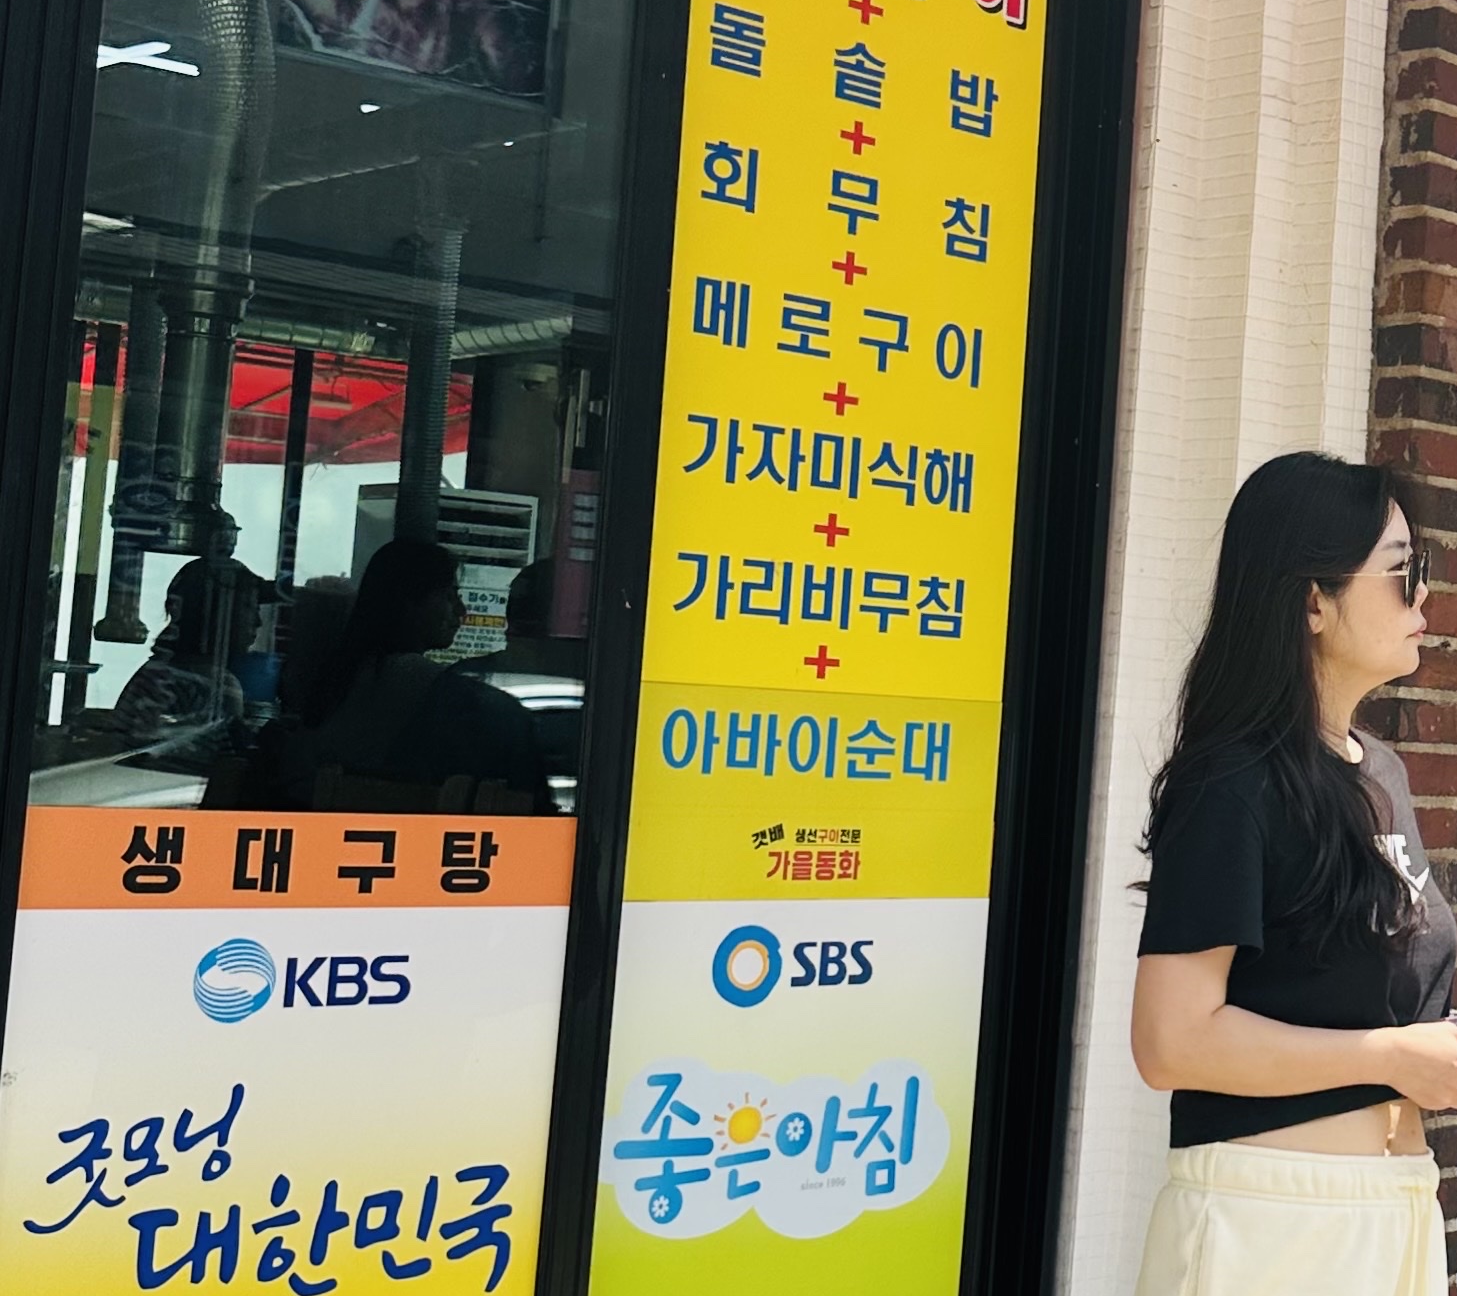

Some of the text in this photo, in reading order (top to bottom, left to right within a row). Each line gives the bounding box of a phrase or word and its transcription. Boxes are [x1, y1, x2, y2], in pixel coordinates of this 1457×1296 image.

[701, 141, 990, 263] 회무침
[693, 276, 983, 388] 메로구이
[683, 414, 974, 513] 가자미식해
[673, 552, 965, 638] 가리비무침
[662, 709, 951, 781] 아바이순대
[121, 826, 499, 895] 생대구탕
[751, 824, 861, 849] 갯배 생선구이전문
[766, 850, 861, 880] 가을동화
[283, 955, 411, 1007] KBS
[790, 940, 873, 987] SBS
[24, 1084, 244, 1235] 굿모닝
[614, 1073, 919, 1223] 좋은아침
[129, 1164, 512, 1296] 대한민국
